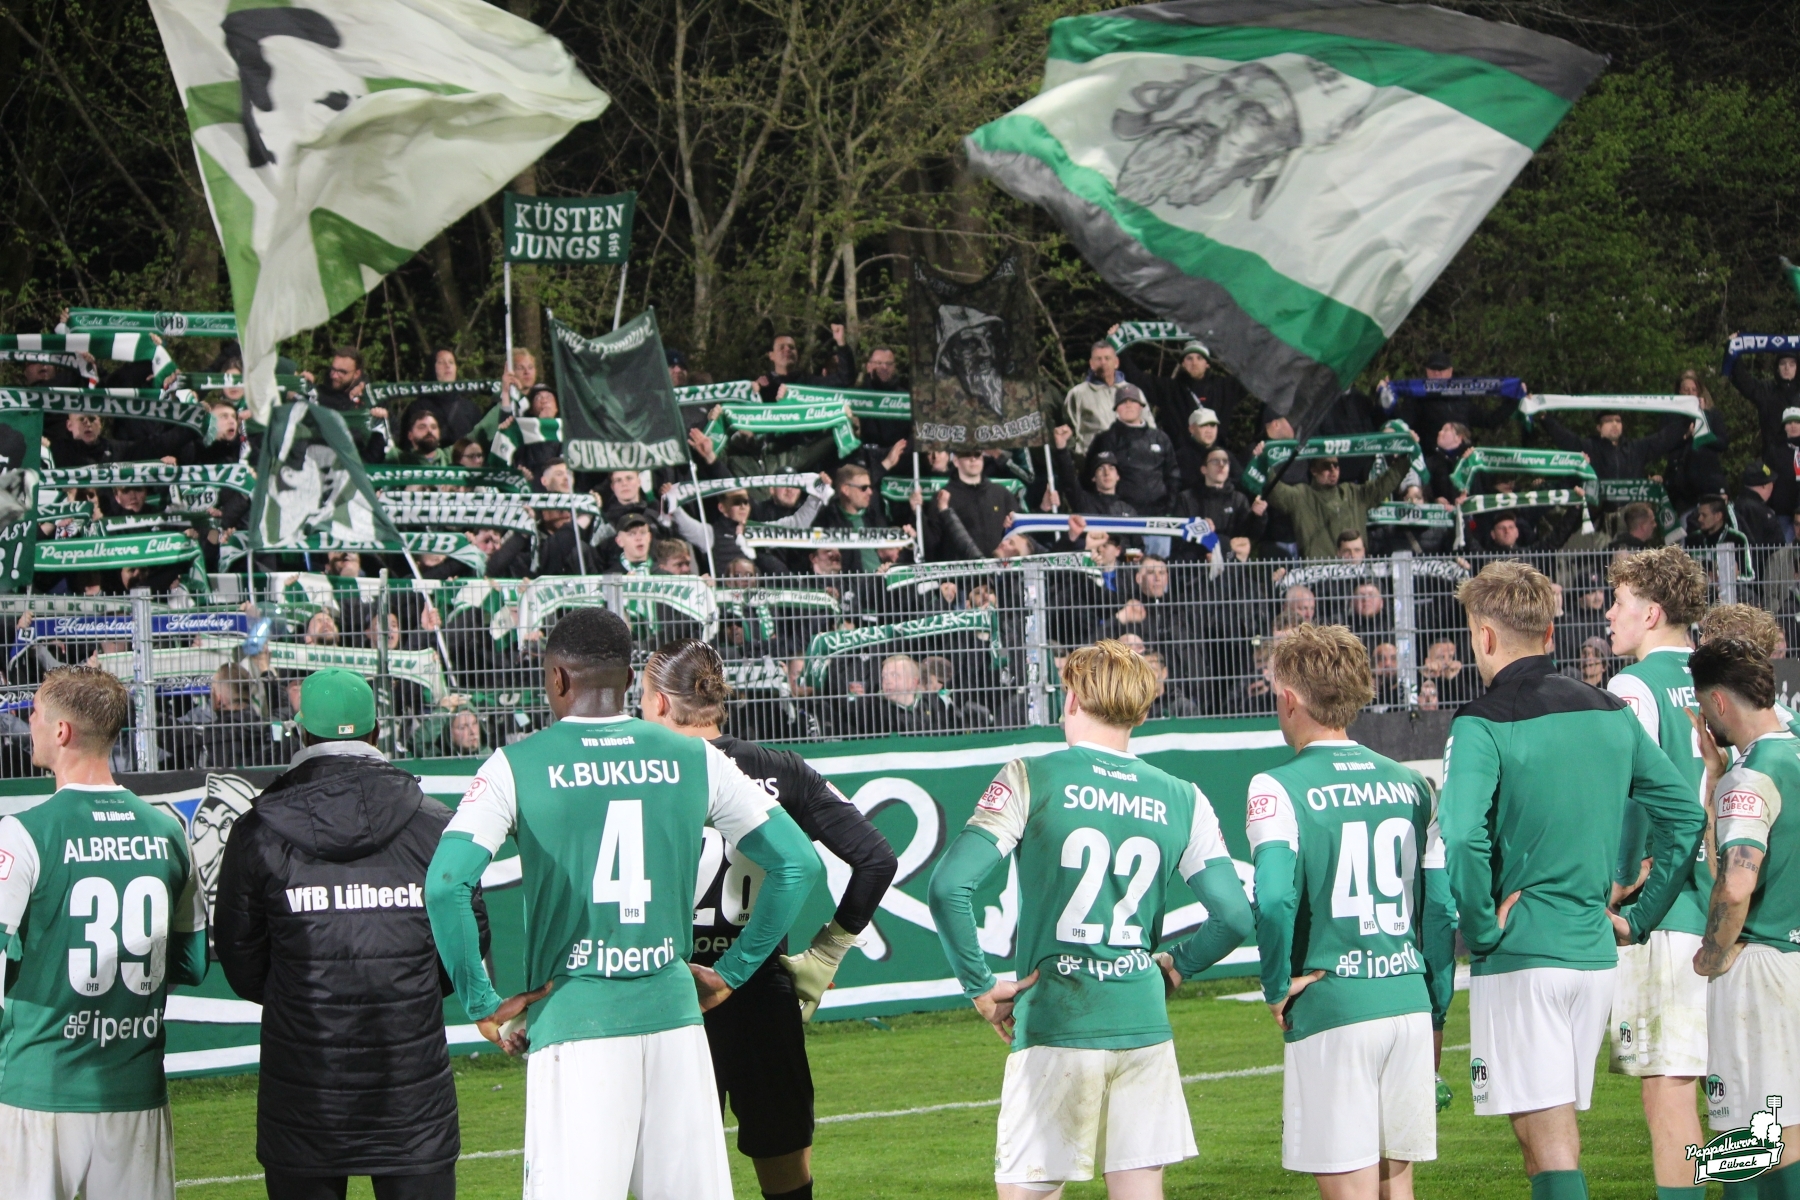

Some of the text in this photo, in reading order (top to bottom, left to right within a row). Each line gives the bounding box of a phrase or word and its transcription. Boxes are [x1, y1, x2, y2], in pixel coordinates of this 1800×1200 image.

[514, 202, 624, 231] KÜSTEN
[510, 231, 601, 260] JUNGS
[608, 232, 621, 258] 1919
[1111, 322, 1187, 347] PAPP
[1471, 489, 1571, 512] 1919
[39, 538, 198, 565] Pappelkurve Lübeck
[53, 612, 235, 634] Hansestad Hamburg
[548, 759, 680, 788] K.BUKUSU
[1063, 784, 1168, 825] SOMMER
[1306, 782, 1420, 811] OTZMANN
[1721, 802, 1755, 813] LÜBECK
[1722, 794, 1756, 805] MAYO
[63, 836, 169, 864] ALBRECHT
[592, 799, 652, 924] 4
[1056, 827, 1161, 945] 22
[1331, 817, 1417, 936] 49
[285, 882, 424, 913] VfB Lübeck
[67, 876, 169, 997] 39
[596, 937, 675, 978] iperdi
[86, 982, 100, 992] VfB
[1471, 1065, 1488, 1082] VfB
[1707, 1081, 1725, 1098] VfB
